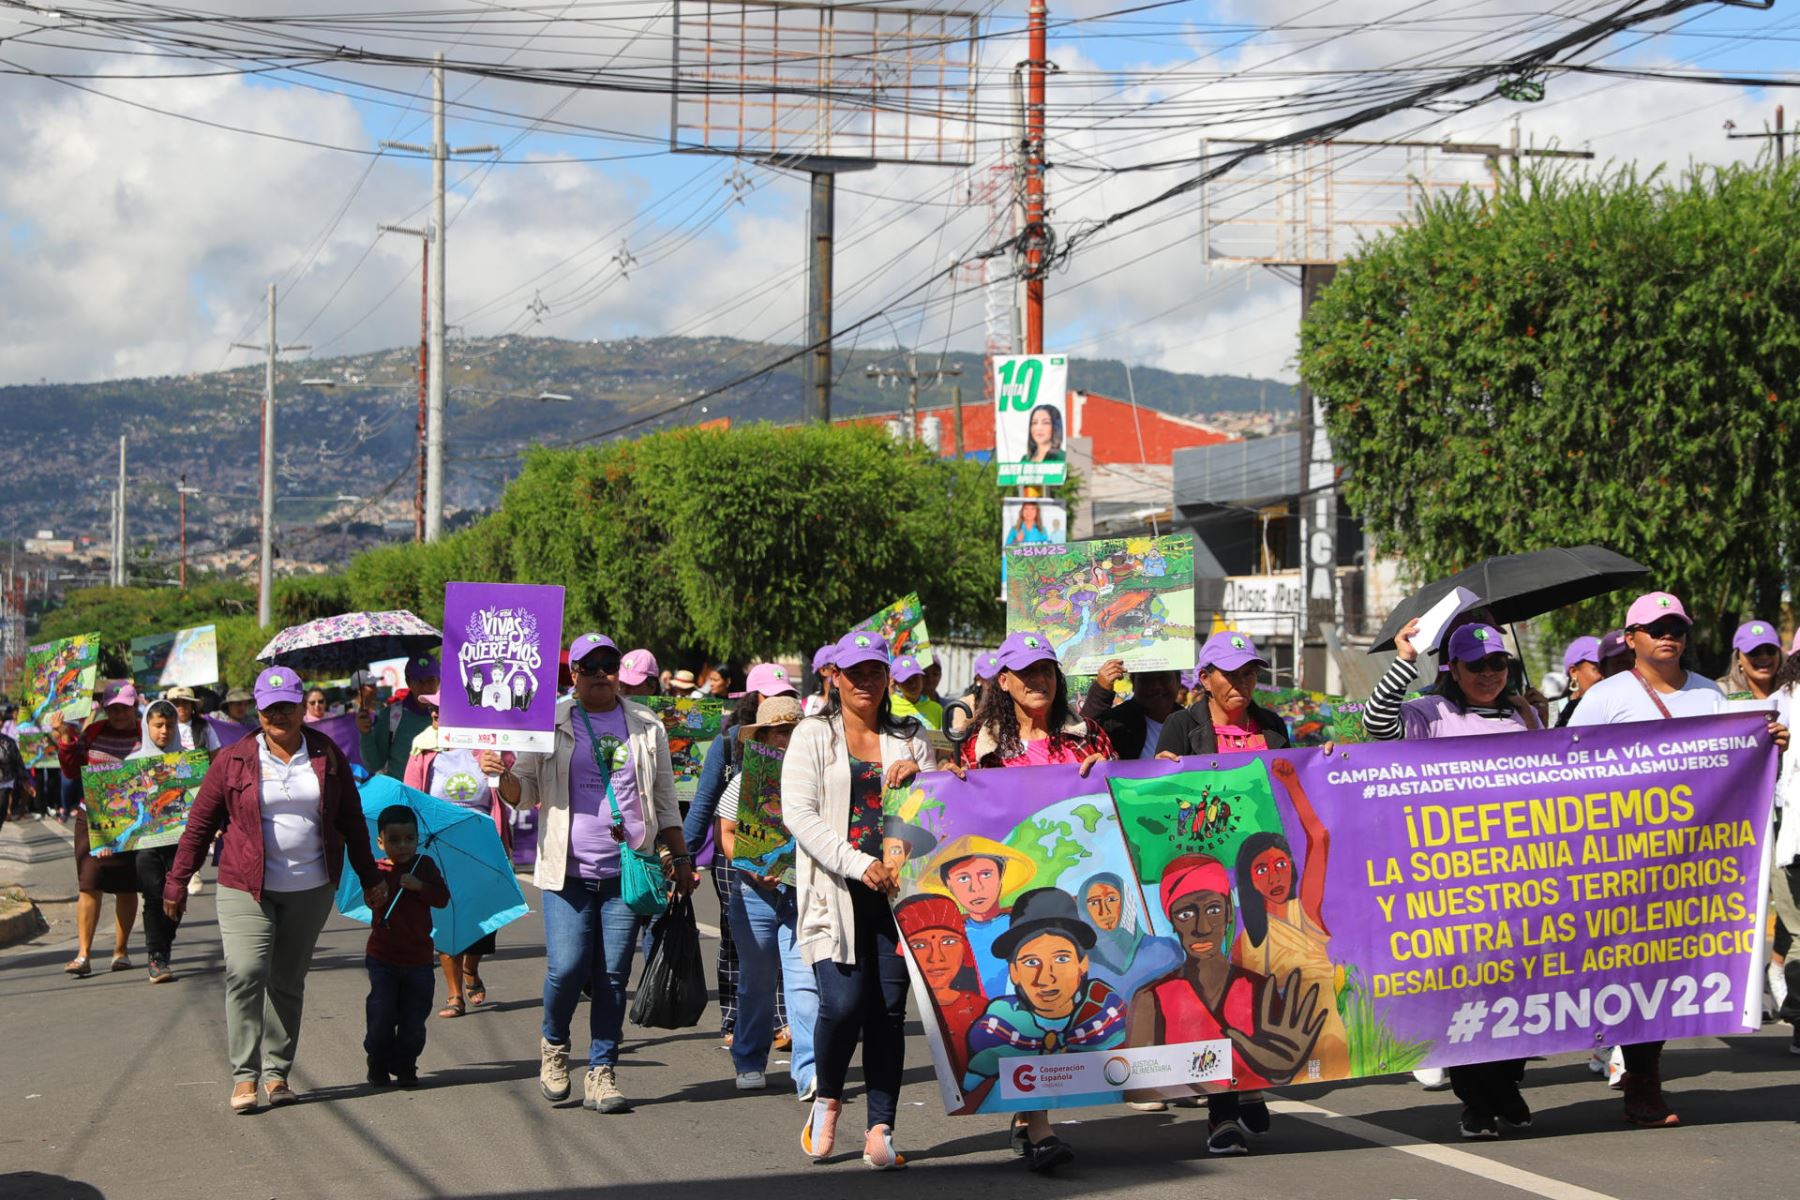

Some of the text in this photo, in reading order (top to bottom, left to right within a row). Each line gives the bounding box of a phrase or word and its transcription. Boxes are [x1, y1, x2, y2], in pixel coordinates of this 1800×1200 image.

[998, 359, 1043, 412] 10
[1013, 545, 1066, 557] #8M25
[480, 609, 524, 643] VIVAS
[459, 640, 541, 669] QUEREMOS
[1327, 735, 1758, 785] CAMPAÑA INTERNACIONAL DE LA VÍA CAMPESINA
[1362, 754, 1729, 799] #BASTADEVIOLENCIACONTRALASMUJERXS
[1404, 784, 1695, 849] ¡DEFENDEMOS
[1366, 819, 1756, 887] LA SOBERANIA ALIMENTARIA
[1376, 856, 1746, 923] Y NUESTROS TERRITORIOS,
[1390, 891, 1757, 961] CONTRA LAS VIOLENCIAS,
[1373, 960, 1516, 998] DESALOJOS
[1521, 957, 1539, 978] Y
[1543, 952, 1574, 977] EL
[1446, 971, 1734, 1044] #25NOV22
[1040, 1064, 1085, 1074] Cooperación
[1041, 1073, 1073, 1082] Española
